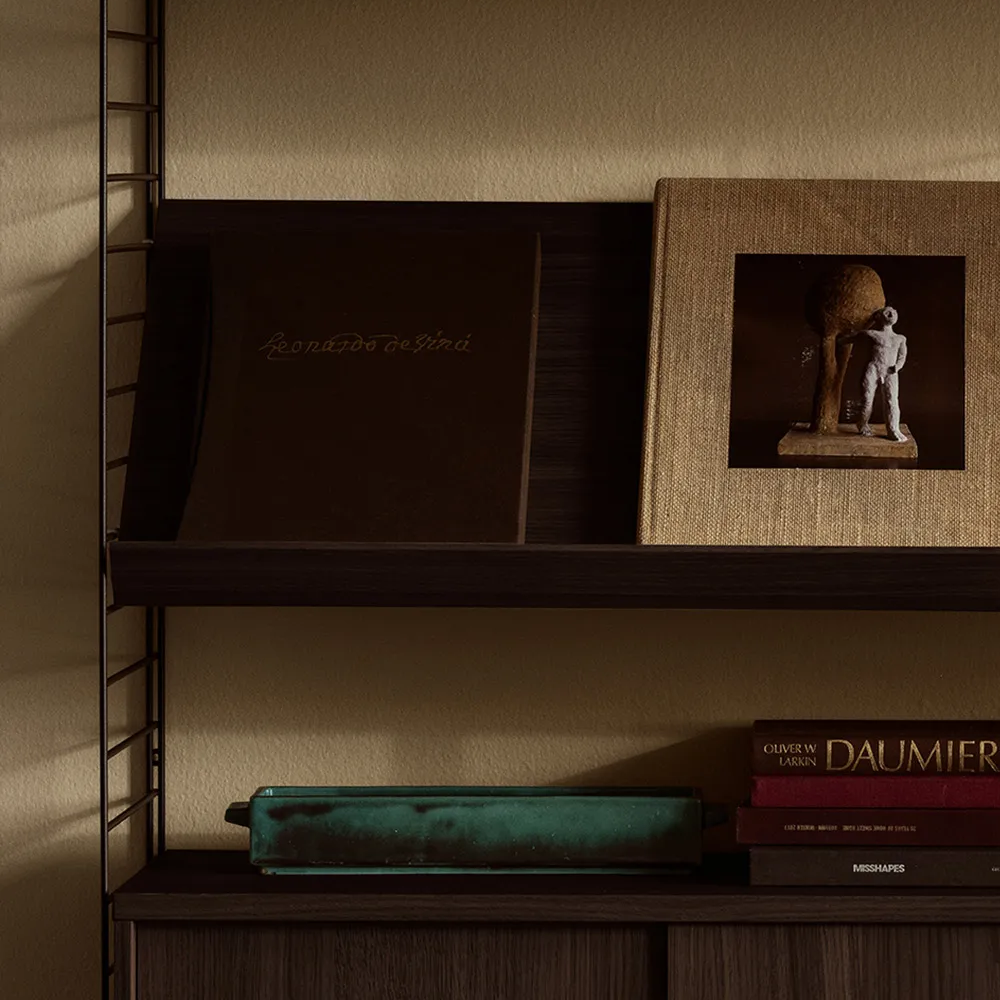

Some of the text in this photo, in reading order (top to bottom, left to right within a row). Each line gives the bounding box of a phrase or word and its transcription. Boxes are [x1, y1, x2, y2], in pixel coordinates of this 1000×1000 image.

[763, 743, 802, 754] OLIVER
[825, 738, 1000, 773] DAUMIER
[779, 756, 817, 767] LARKIN
[853, 863, 906, 873] MISSHAPES
